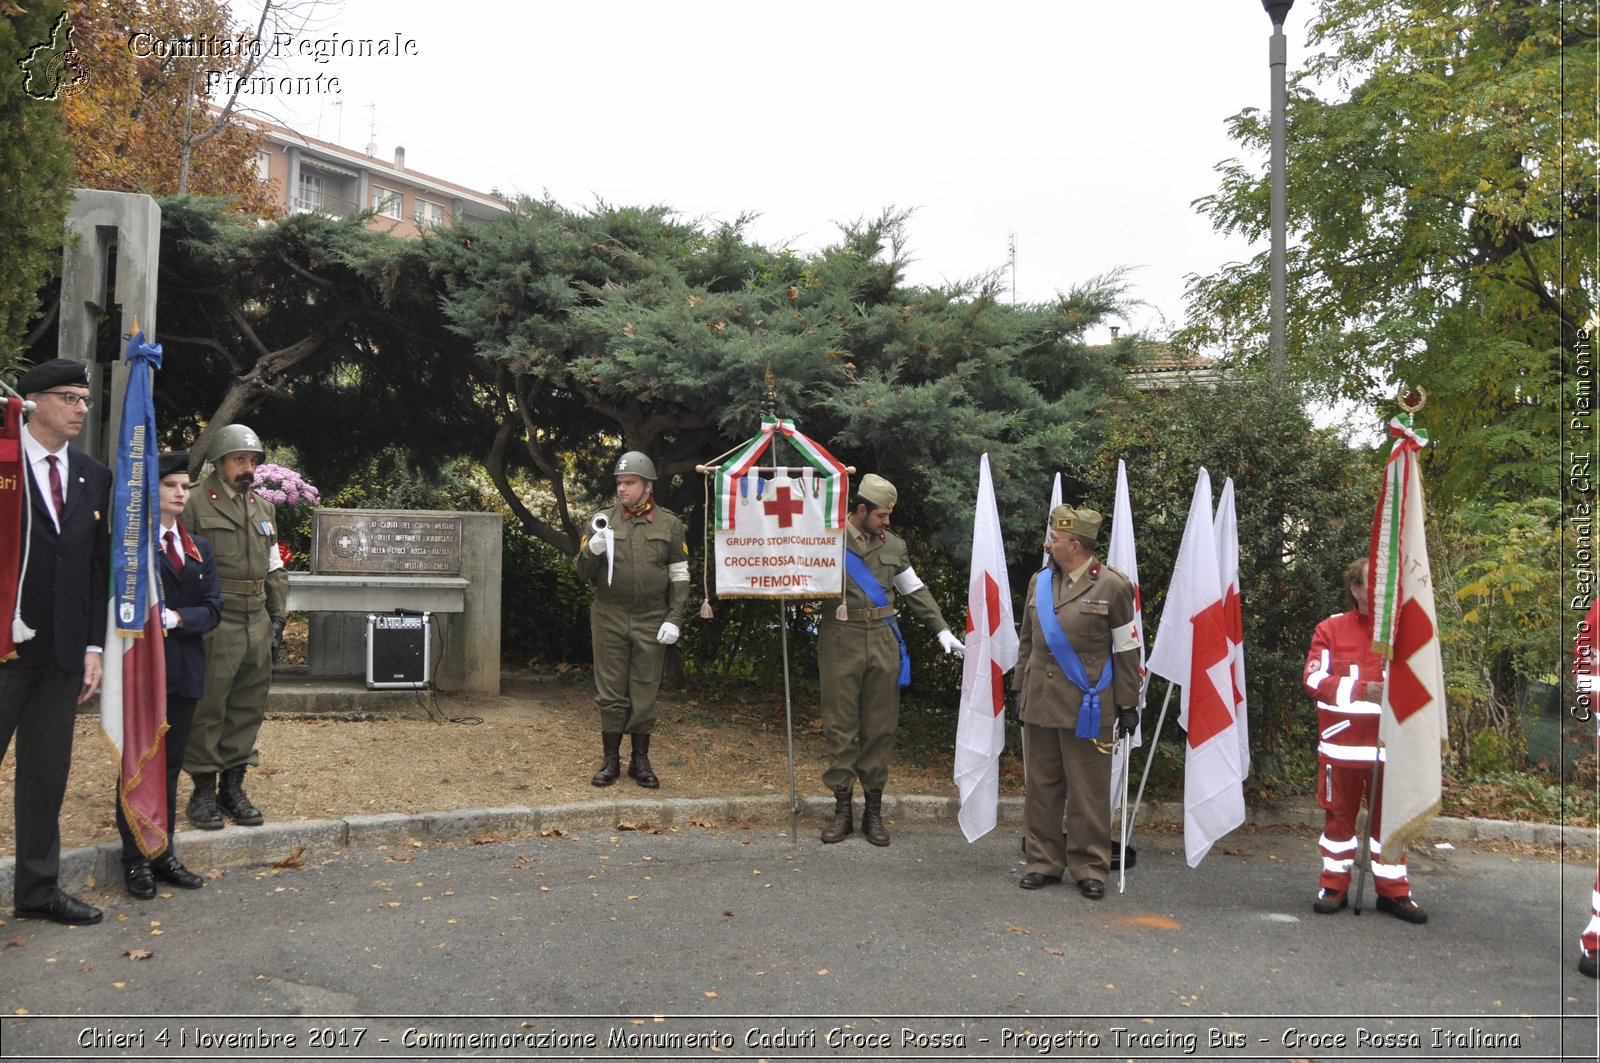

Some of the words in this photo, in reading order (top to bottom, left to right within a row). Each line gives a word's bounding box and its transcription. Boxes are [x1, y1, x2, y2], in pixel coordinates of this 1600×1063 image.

[129, 425, 146, 458] Italiana
[127, 461, 144, 487] Rossa
[126, 488, 142, 512] Croce
[124, 512, 140, 546] Militari
[726, 538, 764, 546] GRUPPO
[767, 536, 800, 545] STORICO
[800, 537, 836, 545] MILITARE
[724, 556, 760, 567] CROCE
[762, 556, 795, 567] ROSSA
[745, 574, 812, 588] "PIEMONTE"
